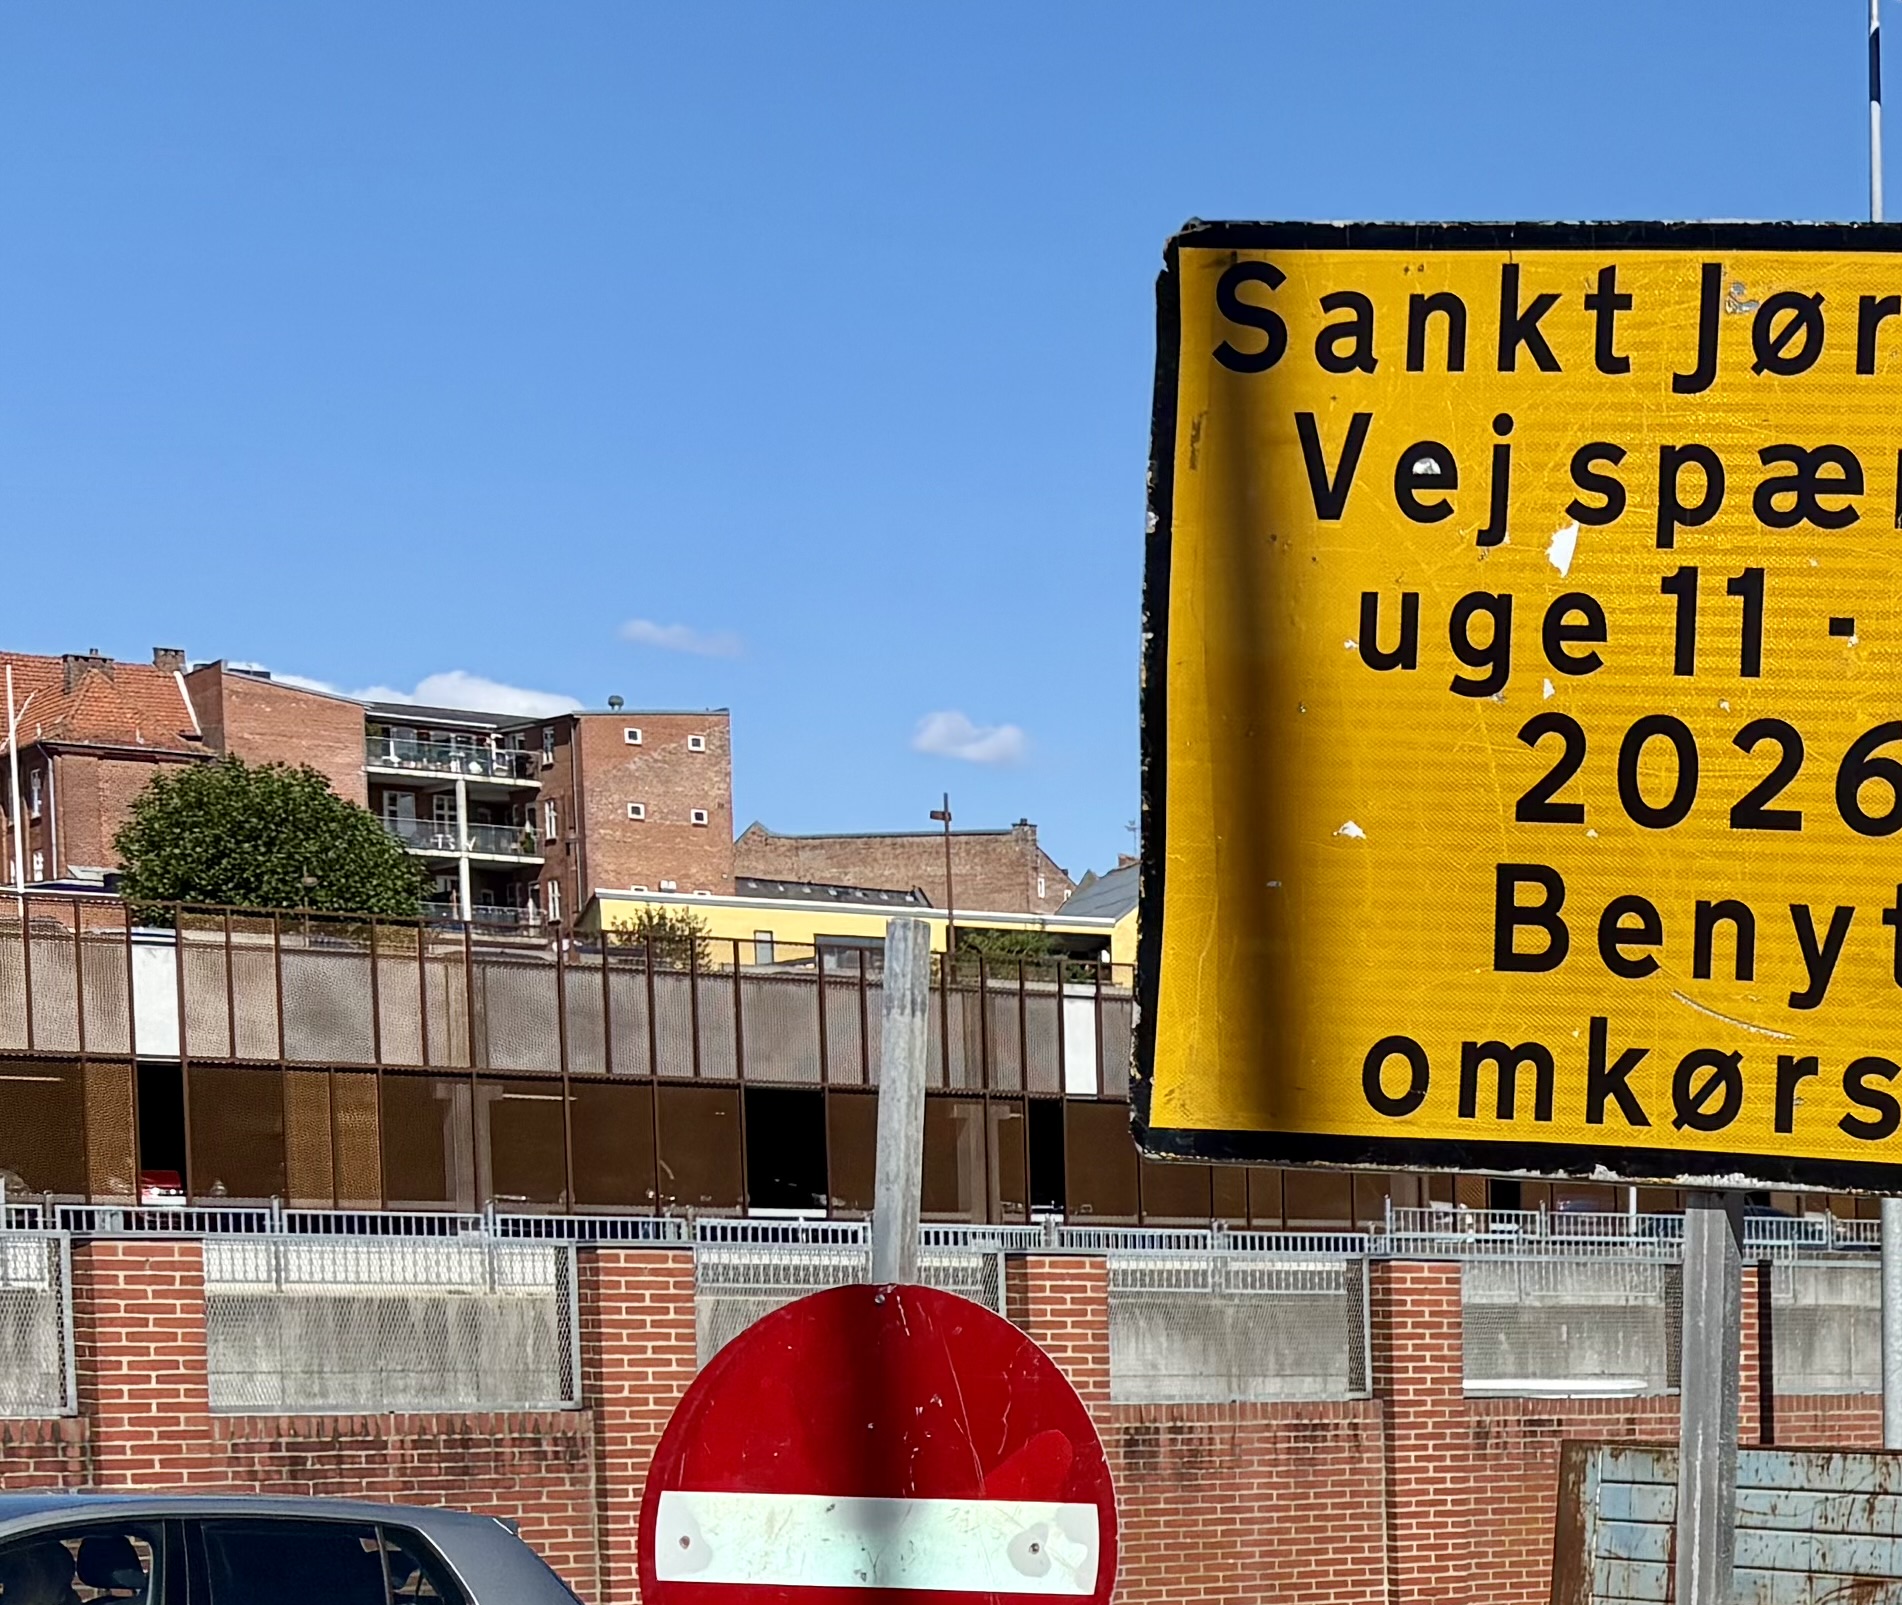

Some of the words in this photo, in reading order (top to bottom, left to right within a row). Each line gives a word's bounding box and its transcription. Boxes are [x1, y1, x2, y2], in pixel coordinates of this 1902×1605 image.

[1212, 261, 1633, 375] Sankt
[1293, 410, 1515, 549] Vej
[1357, 590, 1609, 699] uge
[1659, 564, 1766, 679] 11
[1827, 616, 1856, 638] -
